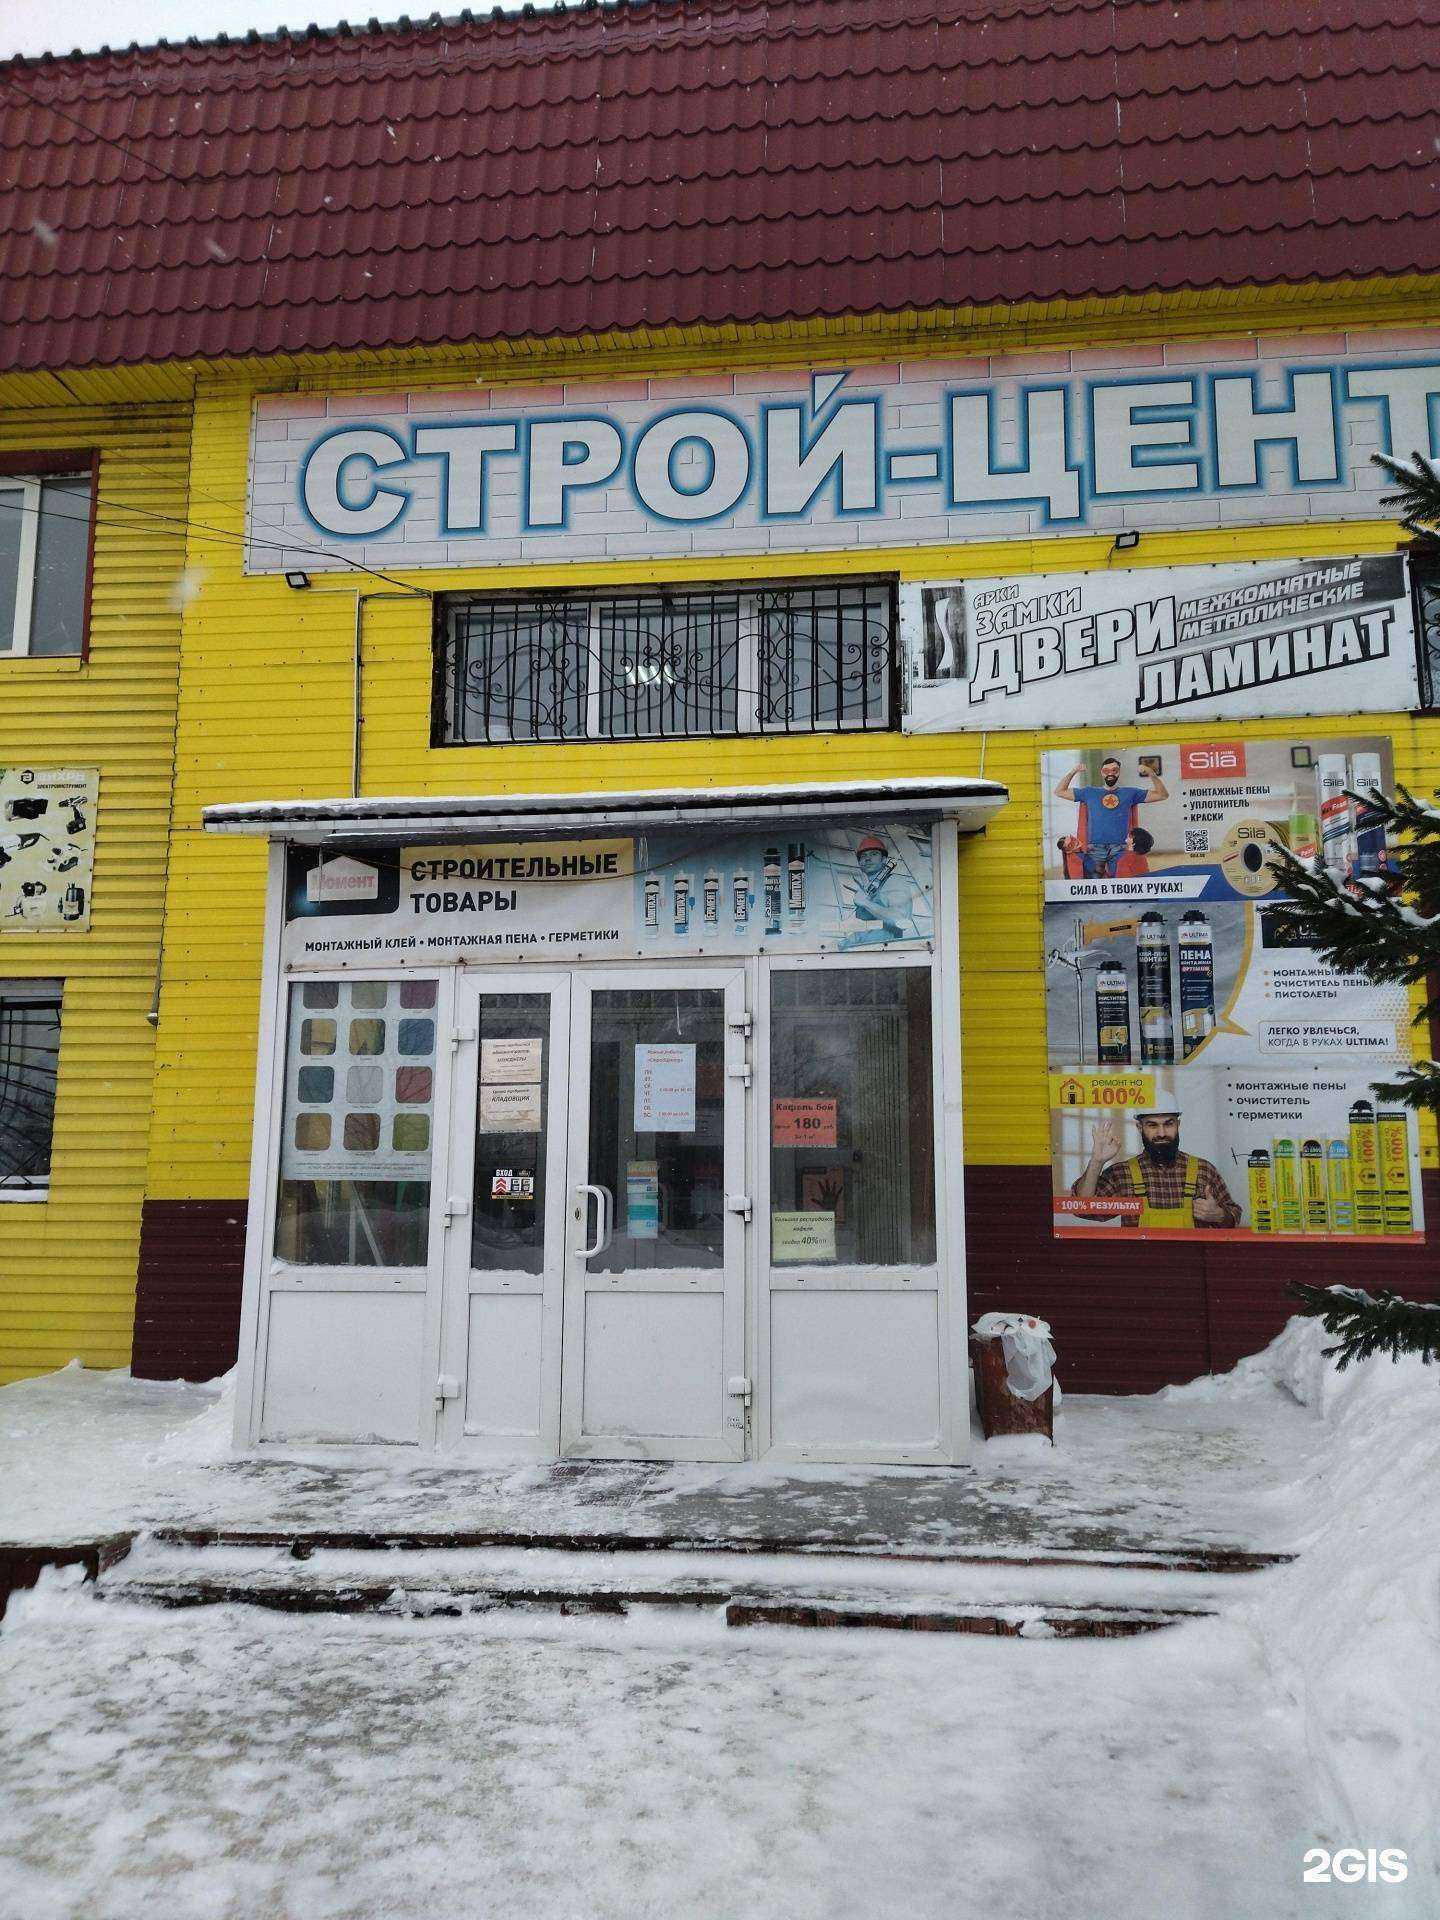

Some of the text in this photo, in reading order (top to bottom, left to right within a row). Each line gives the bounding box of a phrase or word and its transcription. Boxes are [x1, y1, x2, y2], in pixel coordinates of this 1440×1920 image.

[974, 584, 1019, 610] АРКИ
[1177, 560, 1362, 622] МЕЖКОМНАТНЫЕ
[975, 587, 1082, 636] ЗАМКИ
[1179, 581, 1364, 642] МЕТАЛЛИЧЕСКИЕ
[969, 596, 1177, 704] ДВЕРИ
[1136, 607, 1395, 714] ЛАМИНАТ
[1189, 751, 1237, 769] Sila
[1189, 785, 1271, 797] МОНТАЖНЫЕ ПЕНЫ
[1190, 799, 1250, 811] УПЛОТНИТЕЛЬ
[1190, 813, 1224, 822] КРАСКИ
[1237, 827, 1266, 839] Sila
[410, 853, 618, 882] СТРОИТЕЛЬНЫЕ
[1070, 881, 1184, 896] СИЛА В ТВОИХ РУКАХ!
[410, 890, 518, 914] ТОВАРЫ
[305, 930, 619, 952] МОНТАЖНЫЙ КЛЕЙ МОНТАЖНАЯ ПЕНА ГЕРМЕТИКИ
[1180, 950, 1212, 960] ПЕНА
[1274, 979, 1372, 988] ОЧИСТИТЕЛЬ ПЕНЫ
[1275, 991, 1337, 999] ПИСТОЛЕТЫ
[1268, 1026, 1360, 1036] ЛЕГКО УВЛЕЧЬСЯ,
[1268, 1037, 1389, 1048] КОГДА В РУКАХ ULTIMA!
[1236, 1080, 1347, 1092] монтажные пены
[1091, 1088, 1146, 1105] 100%
[1236, 1095, 1311, 1106] очиститель
[1237, 1110, 1303, 1122] герметики
[794, 1117, 821, 1129] 180
[1062, 1200, 1141, 1211] 100% РЕЗУЛЬТАТ
